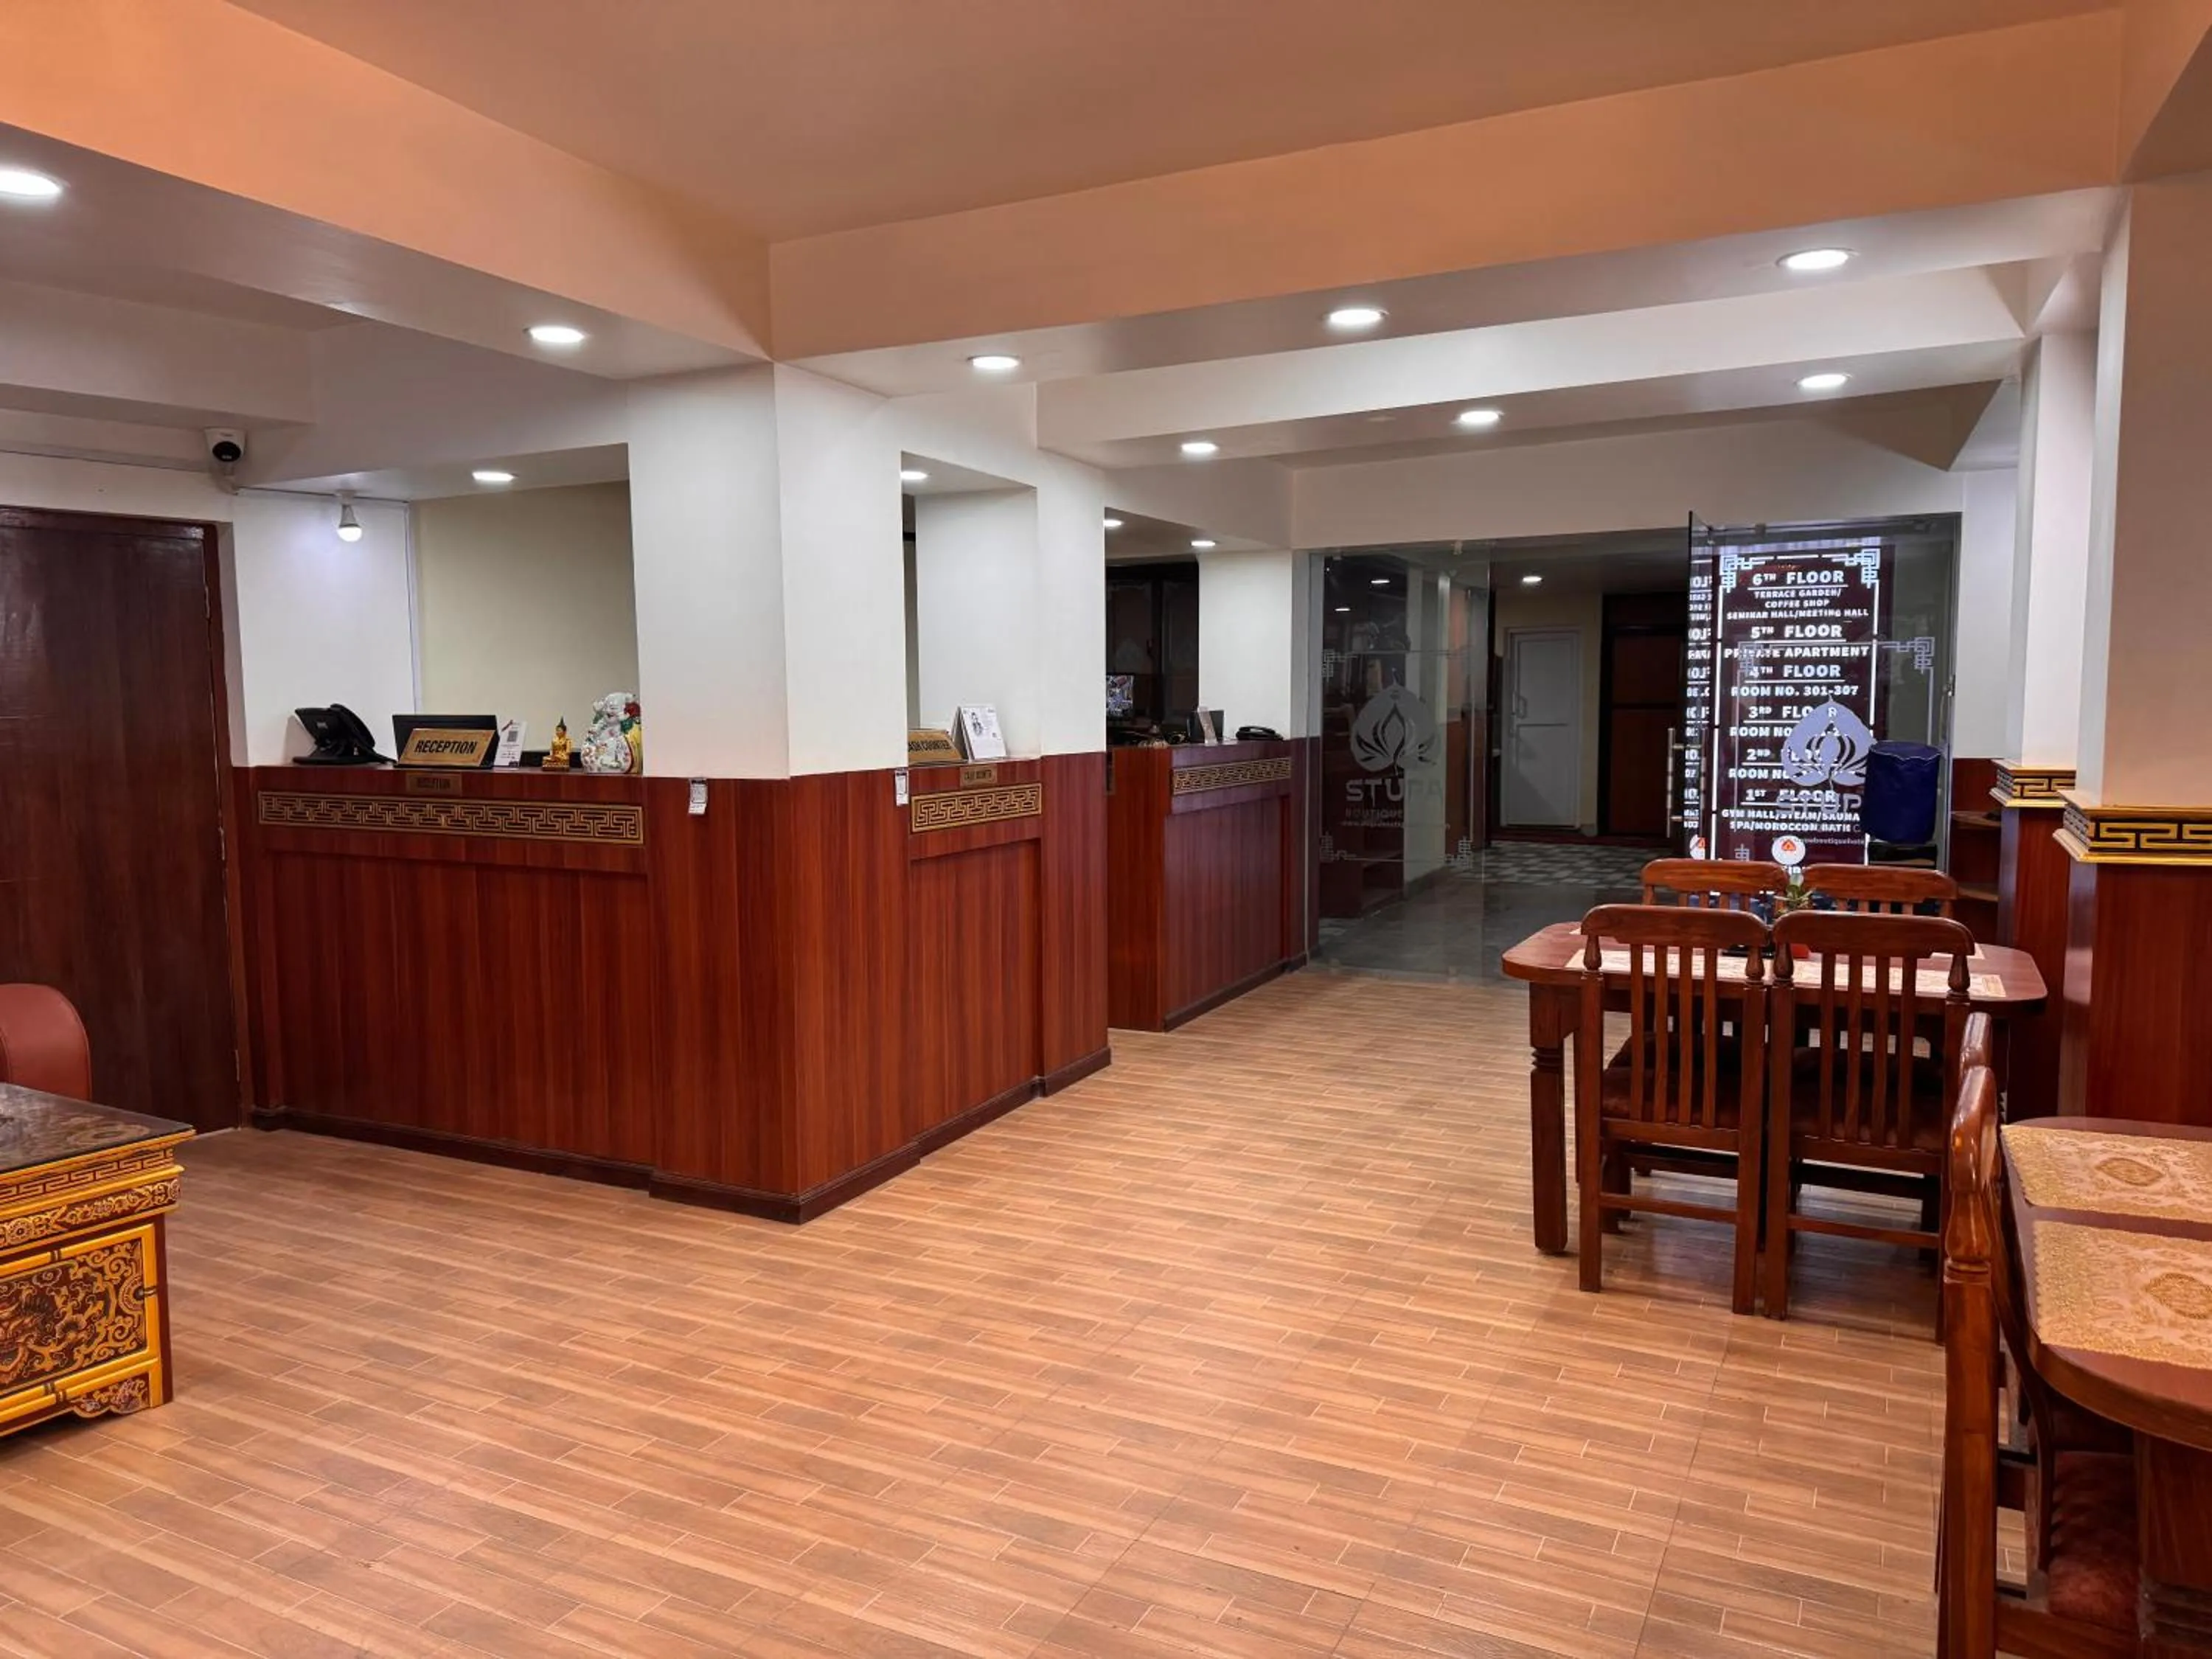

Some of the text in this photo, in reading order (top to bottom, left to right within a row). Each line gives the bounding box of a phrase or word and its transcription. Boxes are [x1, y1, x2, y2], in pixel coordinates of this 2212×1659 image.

[1752, 570, 1844, 585] 6TH FLOOR
[1753, 590, 1795, 599] TERRACE
[1764, 599, 1830, 608] COFFEE SHOP
[1726, 611, 1769, 620] SEMINAR
[1843, 608, 1869, 617] HALL
[1750, 624, 1842, 639] 5TH FLOOR
[1784, 646, 1869, 658] APARTMENT
[1783, 664, 1841, 678] FLOOR
[1731, 685, 1859, 697] ROOM NO. 301-307
[1748, 705, 1837, 719] 3RD FLOR
[1729, 726, 1770, 737] ROOM
[414, 740, 478, 754] RECEPTION
[1728, 768, 1770, 779] ROOM
[1745, 788, 1837, 802] 1ST FLOOR
[1722, 810, 1745, 819] GYM
